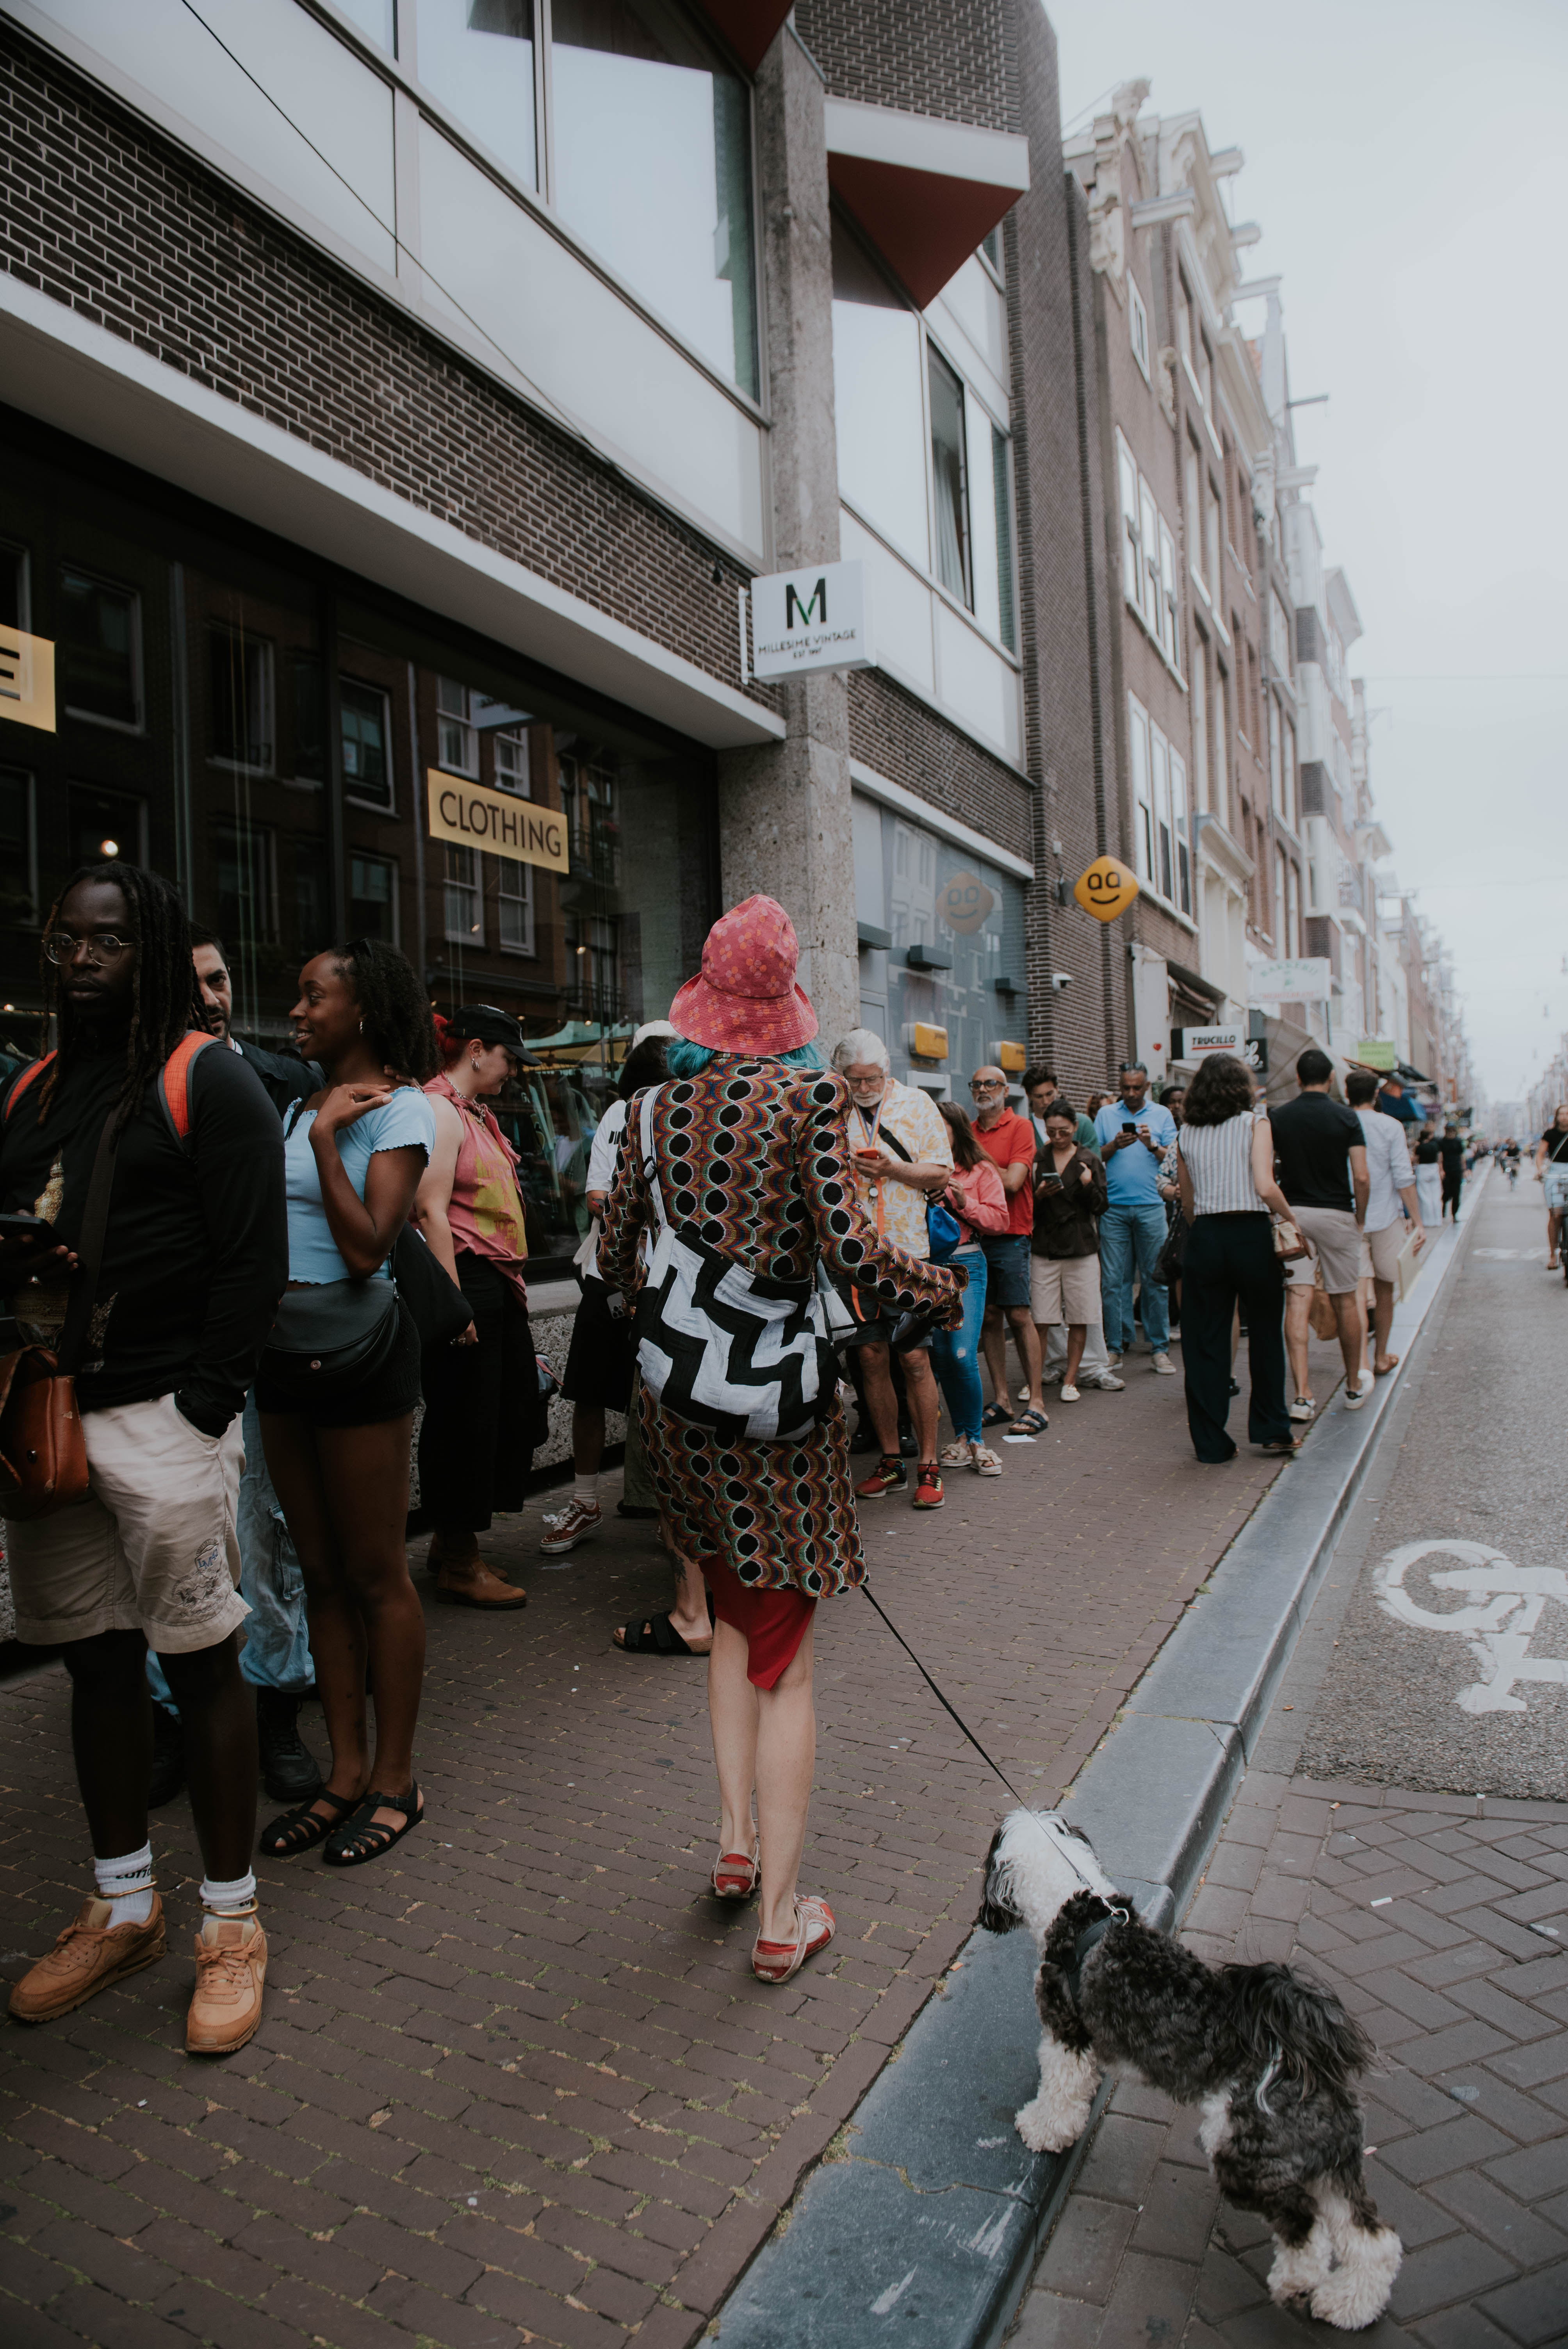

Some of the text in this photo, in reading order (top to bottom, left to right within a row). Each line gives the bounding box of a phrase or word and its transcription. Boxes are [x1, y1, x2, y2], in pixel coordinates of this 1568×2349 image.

[786, 578, 826, 629] M
[759, 629, 856, 654] MILLESIME VINTAGE
[439, 790, 561, 857] CLOTHING
[1192, 1035, 1236, 1045] TRUCILLO
